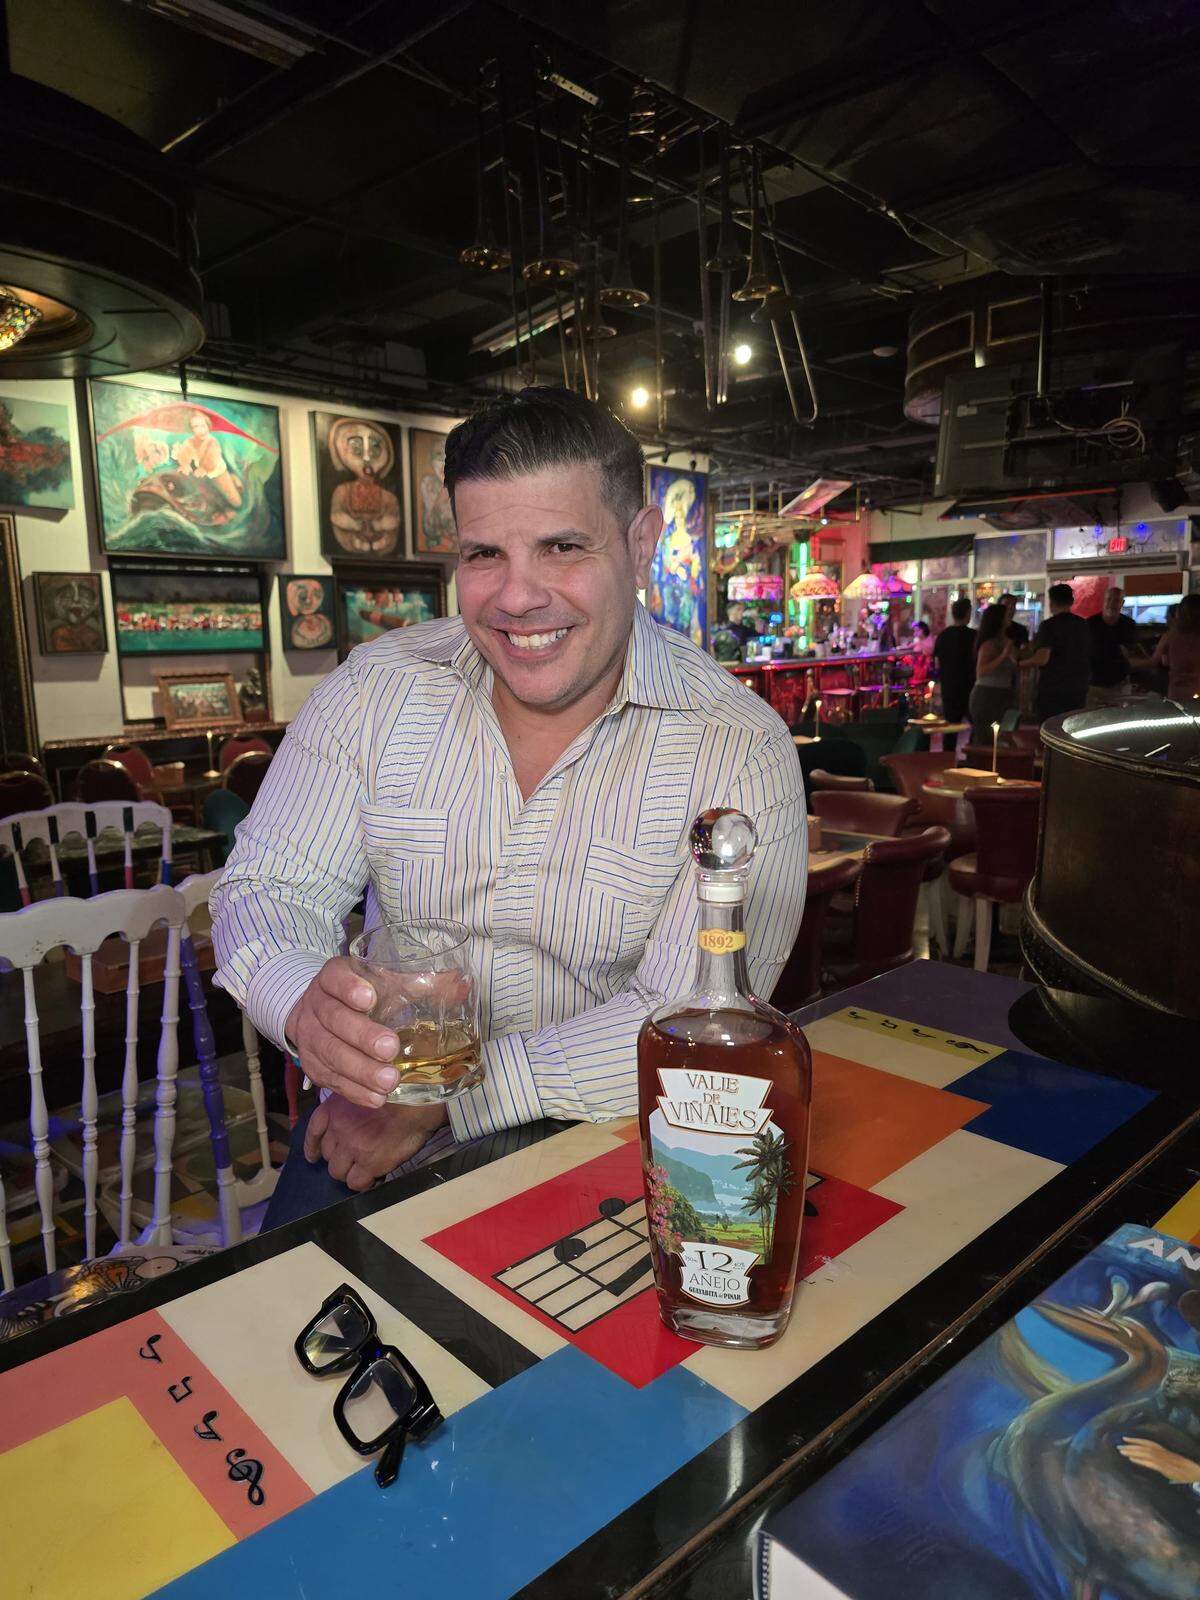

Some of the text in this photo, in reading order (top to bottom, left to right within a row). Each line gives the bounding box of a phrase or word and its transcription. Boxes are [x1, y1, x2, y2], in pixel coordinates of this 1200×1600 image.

[1110, 539, 1126, 552] EXIT
[703, 934, 734, 948] 1892
[686, 1072, 739, 1093] VALLE
[703, 1092, 720, 1105] DE
[670, 1100, 756, 1130] VIÑALES
[695, 1250, 733, 1273] 12
[689, 1272, 741, 1292] AÑEJO
[723, 1292, 742, 1301] PINAR
